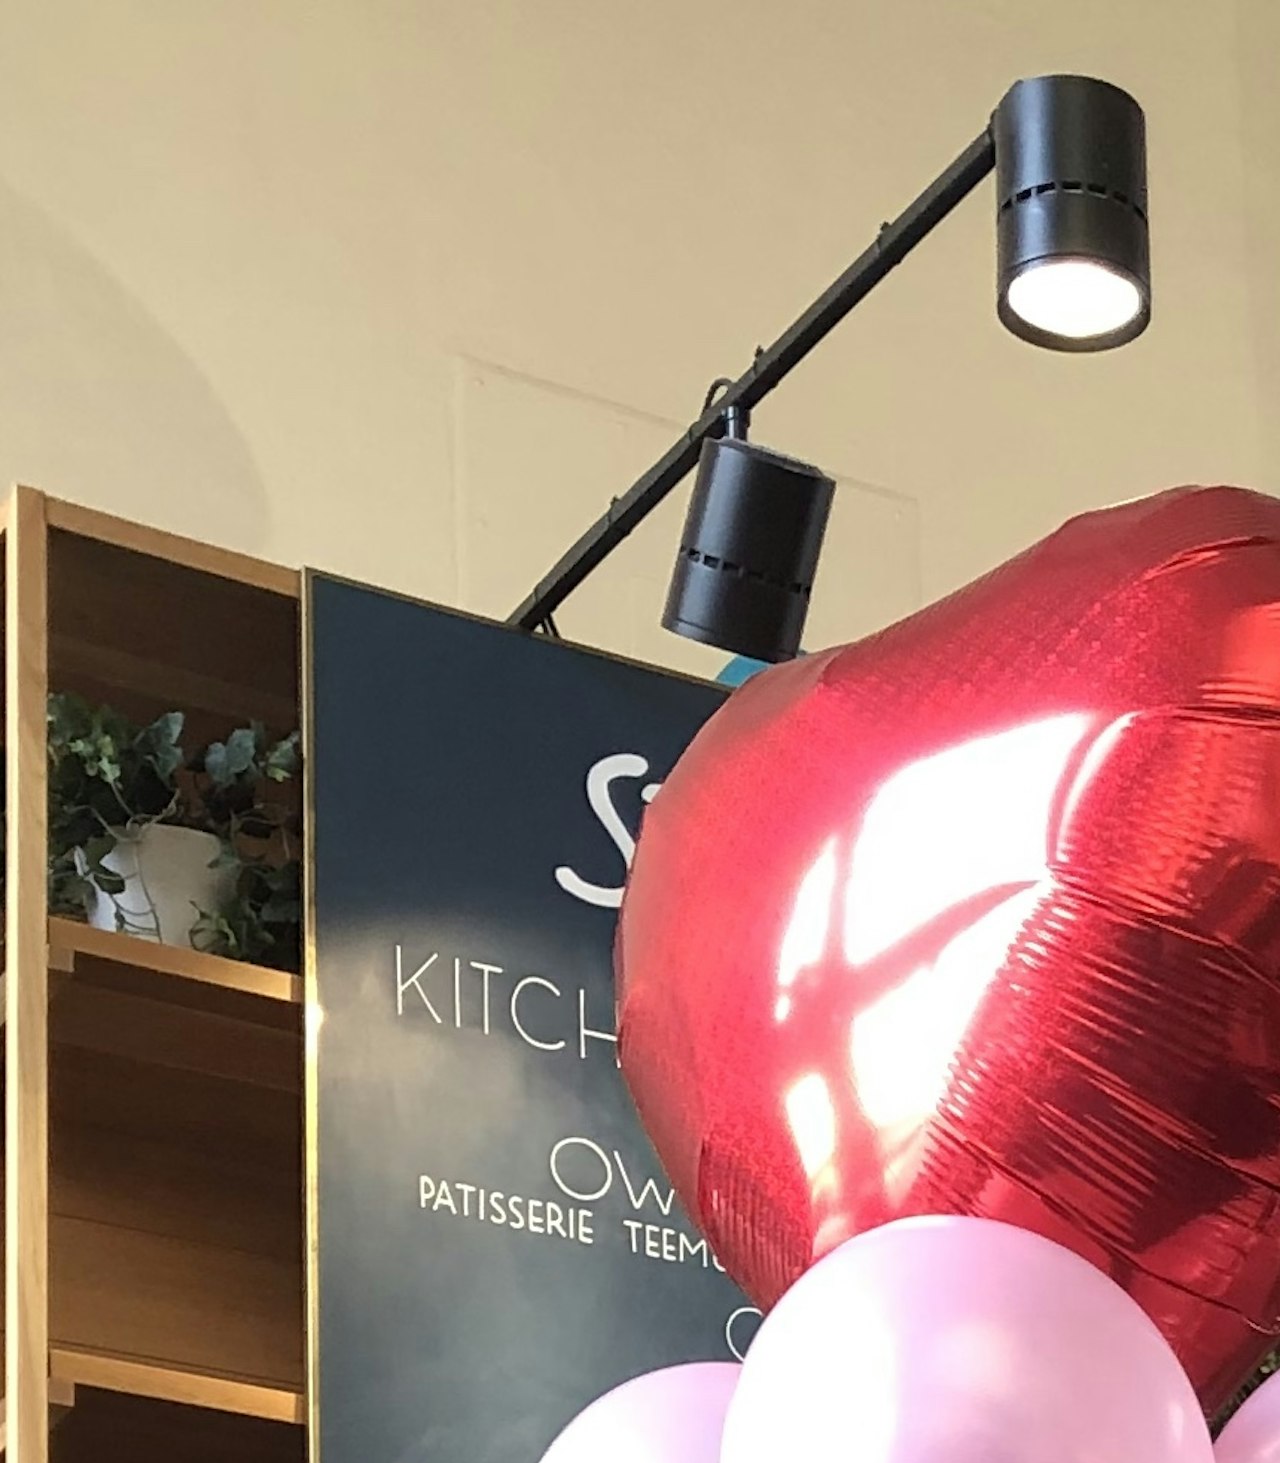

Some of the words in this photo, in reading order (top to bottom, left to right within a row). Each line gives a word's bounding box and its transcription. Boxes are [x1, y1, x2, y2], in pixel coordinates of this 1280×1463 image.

[395, 943, 622, 1067] KITCH
[419, 1175, 594, 1244] PATISSERIE
[550, 1137, 676, 1215] OW
